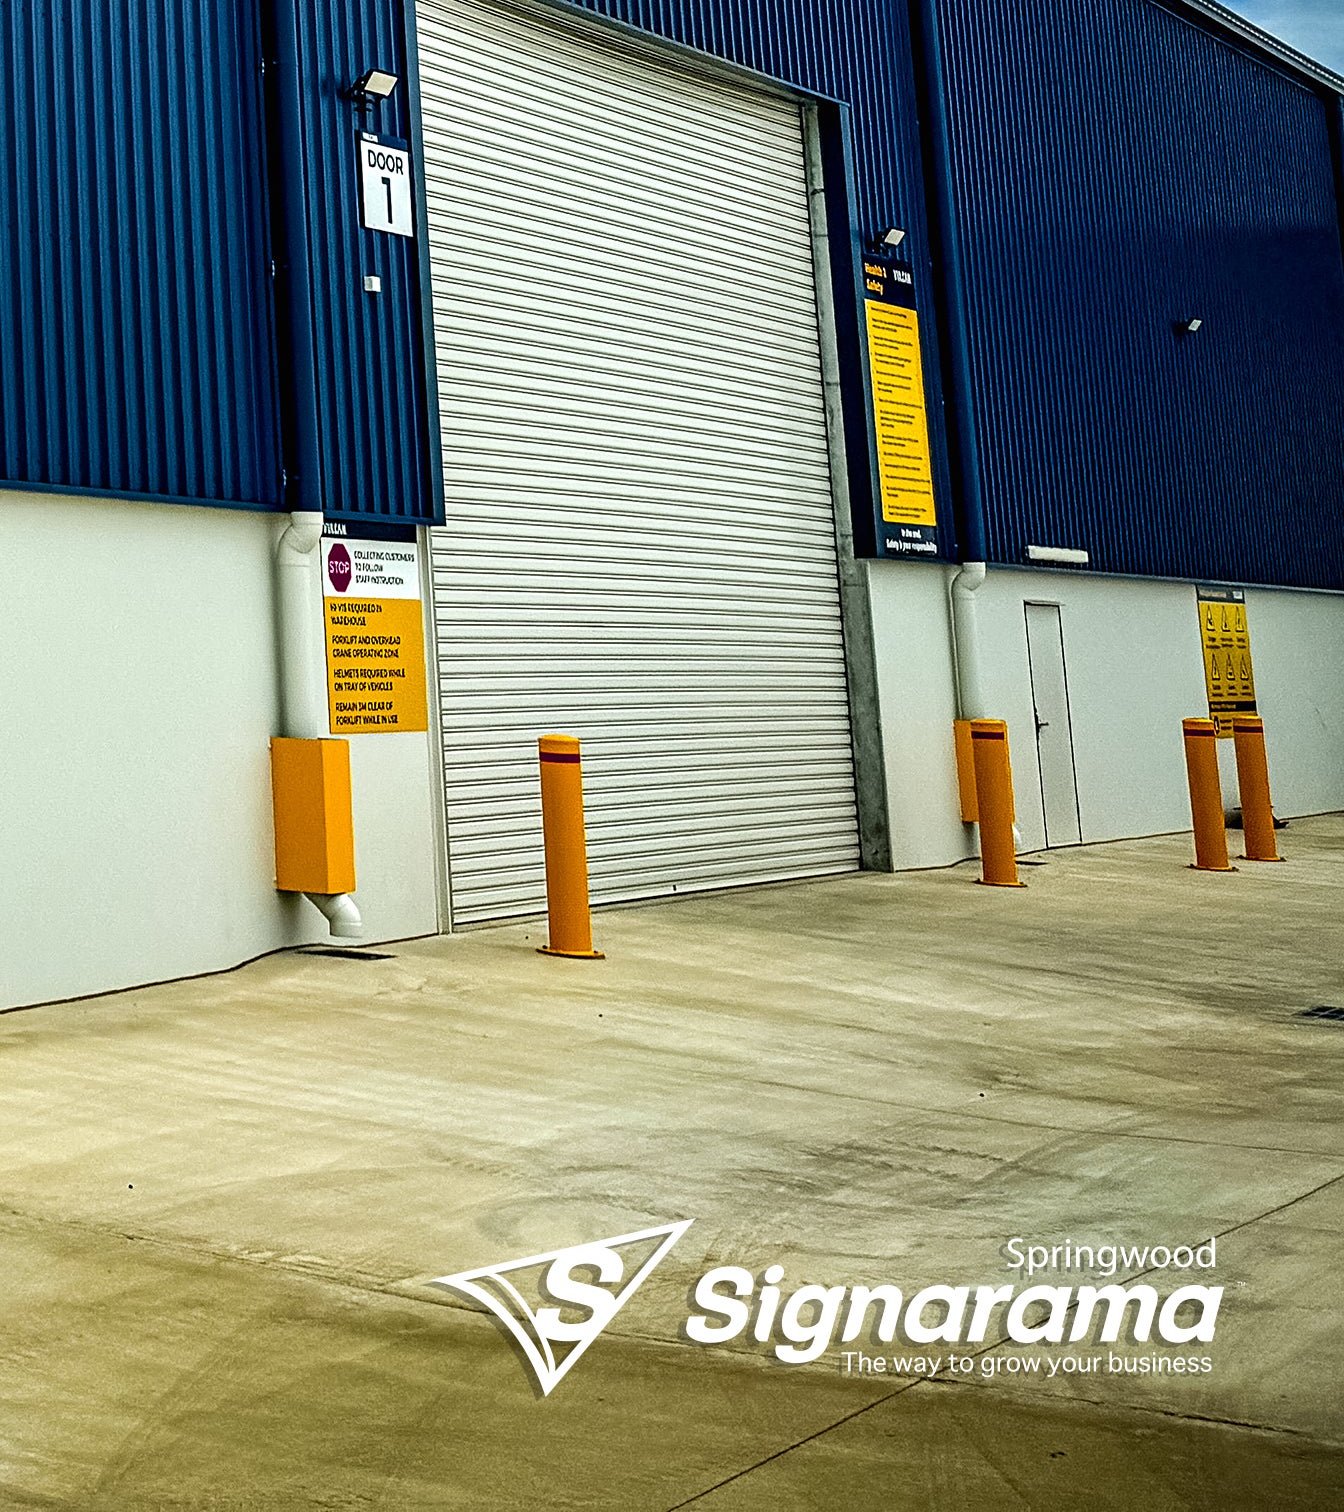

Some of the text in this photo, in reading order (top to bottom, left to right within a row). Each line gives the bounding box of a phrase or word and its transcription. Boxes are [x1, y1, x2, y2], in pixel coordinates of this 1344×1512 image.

[368, 149, 404, 175] DOOR
[381, 176, 393, 225] 1
[329, 561, 350, 574] STOP
[332, 635, 401, 645] FORKLIFT AND OVERHEAD
[332, 648, 399, 658] CRANE OPERATING ZONE
[333, 668, 359, 678] HELMETS
[359, 669, 388, 679] REQUIRED
[334, 682, 393, 691] ON TRAY OF VEHICLES
[335, 702, 357, 712] REMAIN
[367, 702, 385, 711] CLEAR
[385, 701, 393, 710] OF
[336, 715, 361, 725] FORKLIFT
[362, 715, 380, 724] WHILE
